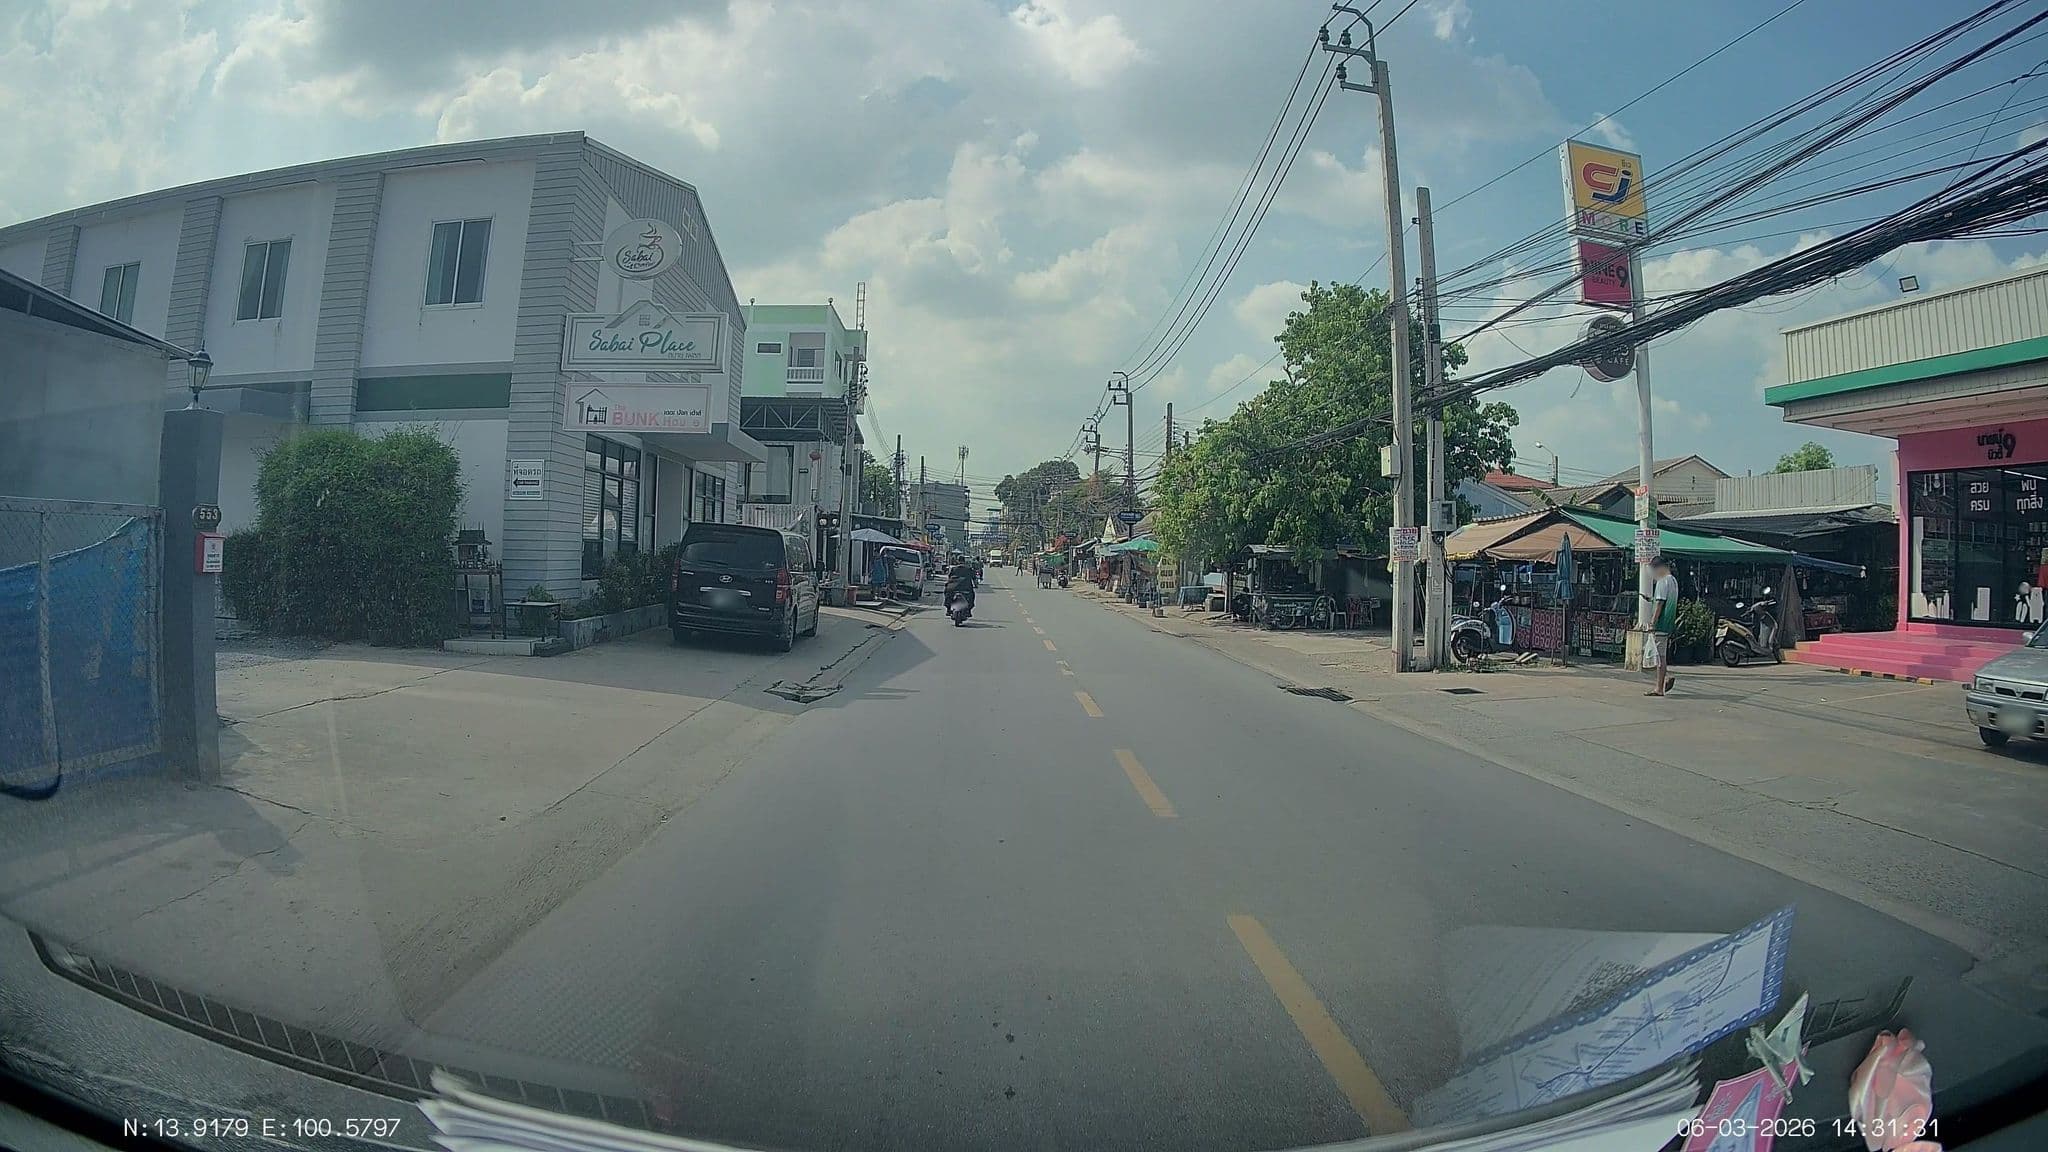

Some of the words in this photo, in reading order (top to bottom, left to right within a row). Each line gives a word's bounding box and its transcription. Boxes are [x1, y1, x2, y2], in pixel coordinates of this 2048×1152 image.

[622, 249, 654, 263] Sabai
[1616, 265, 1629, 288] 9
[589, 329, 634, 353] Sabai
[639, 330, 696, 354] Place
[612, 411, 660, 426] BUNK
[1970, 481, 1989, 494] สวย
[1970, 499, 1990, 511] ครบ
[2016, 491, 2043, 514] ทุกสิ่ง
[199, 508, 218, 520] 553
